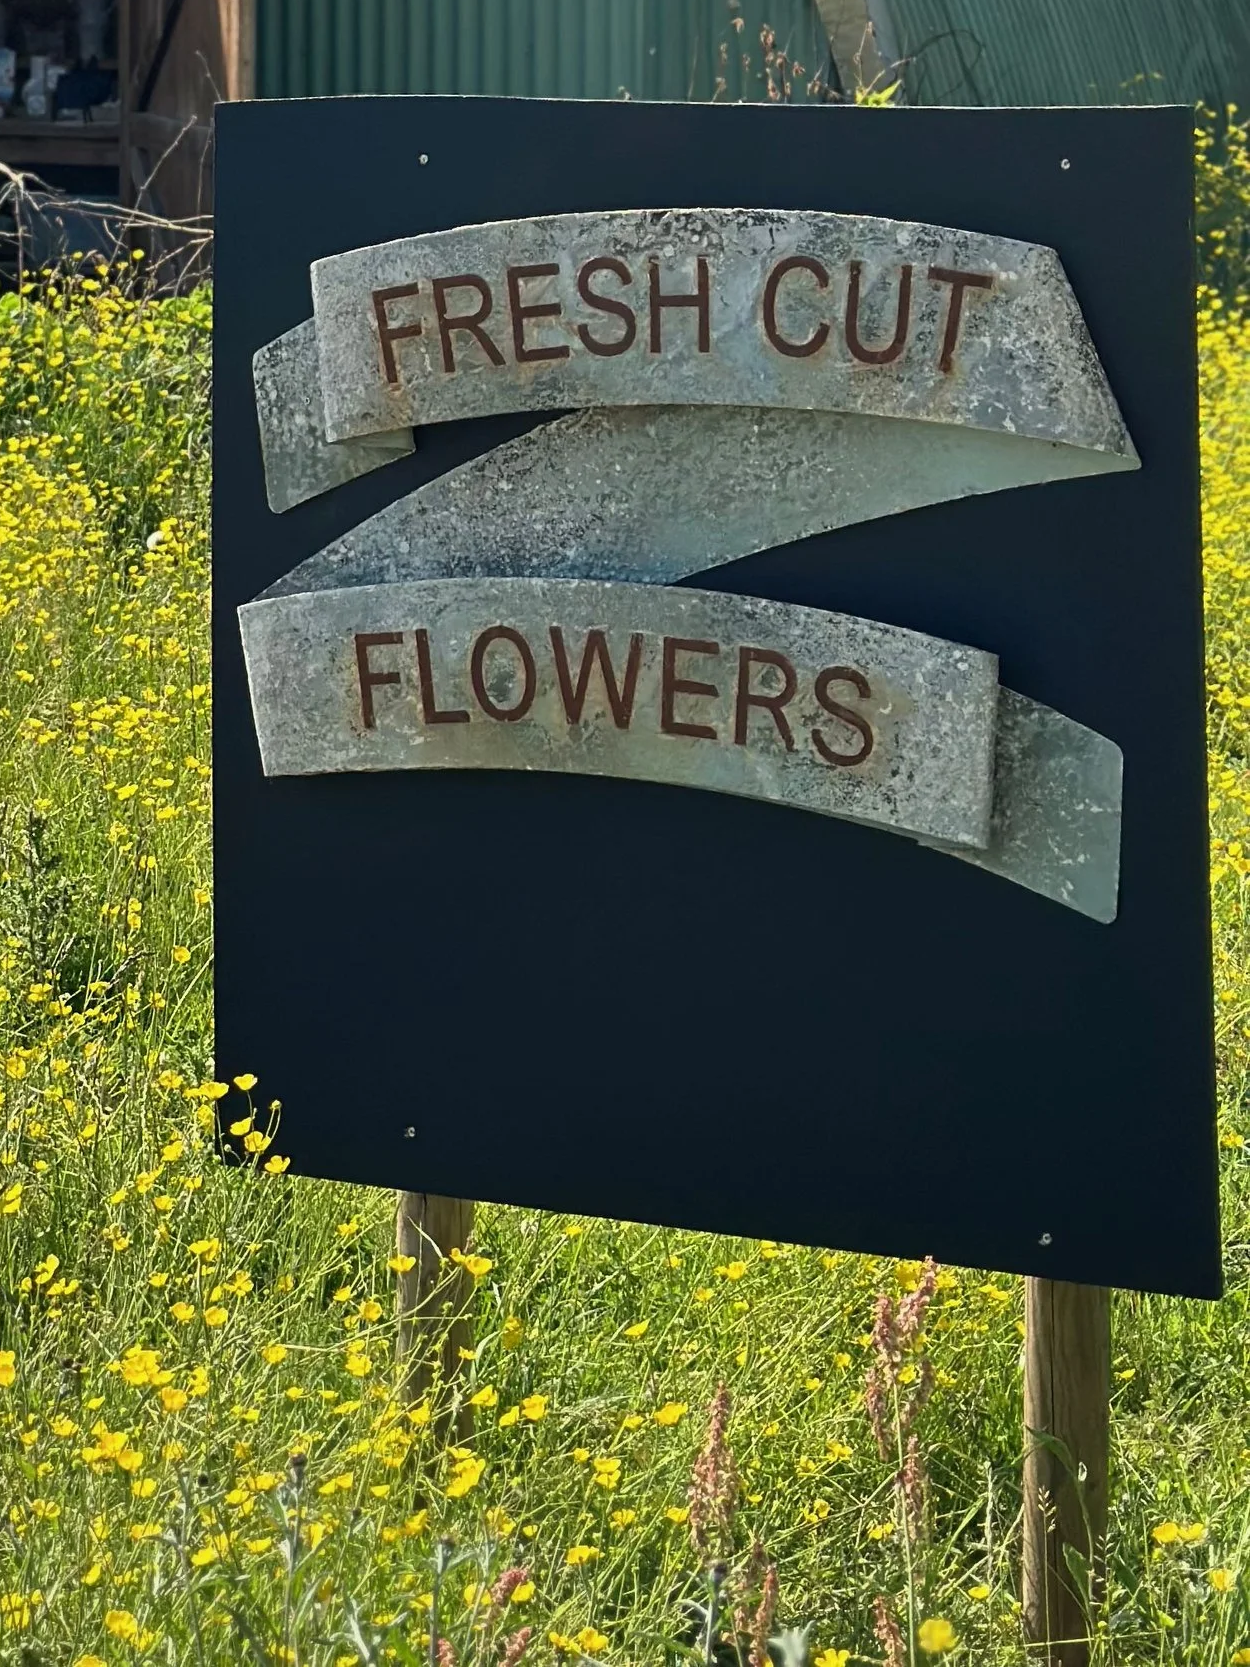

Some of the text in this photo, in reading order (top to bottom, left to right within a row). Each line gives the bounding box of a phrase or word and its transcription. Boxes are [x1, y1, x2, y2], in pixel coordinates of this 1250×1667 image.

[371, 254, 995, 384] FRESH CUT
[354, 624, 876, 769] FLOWERS
